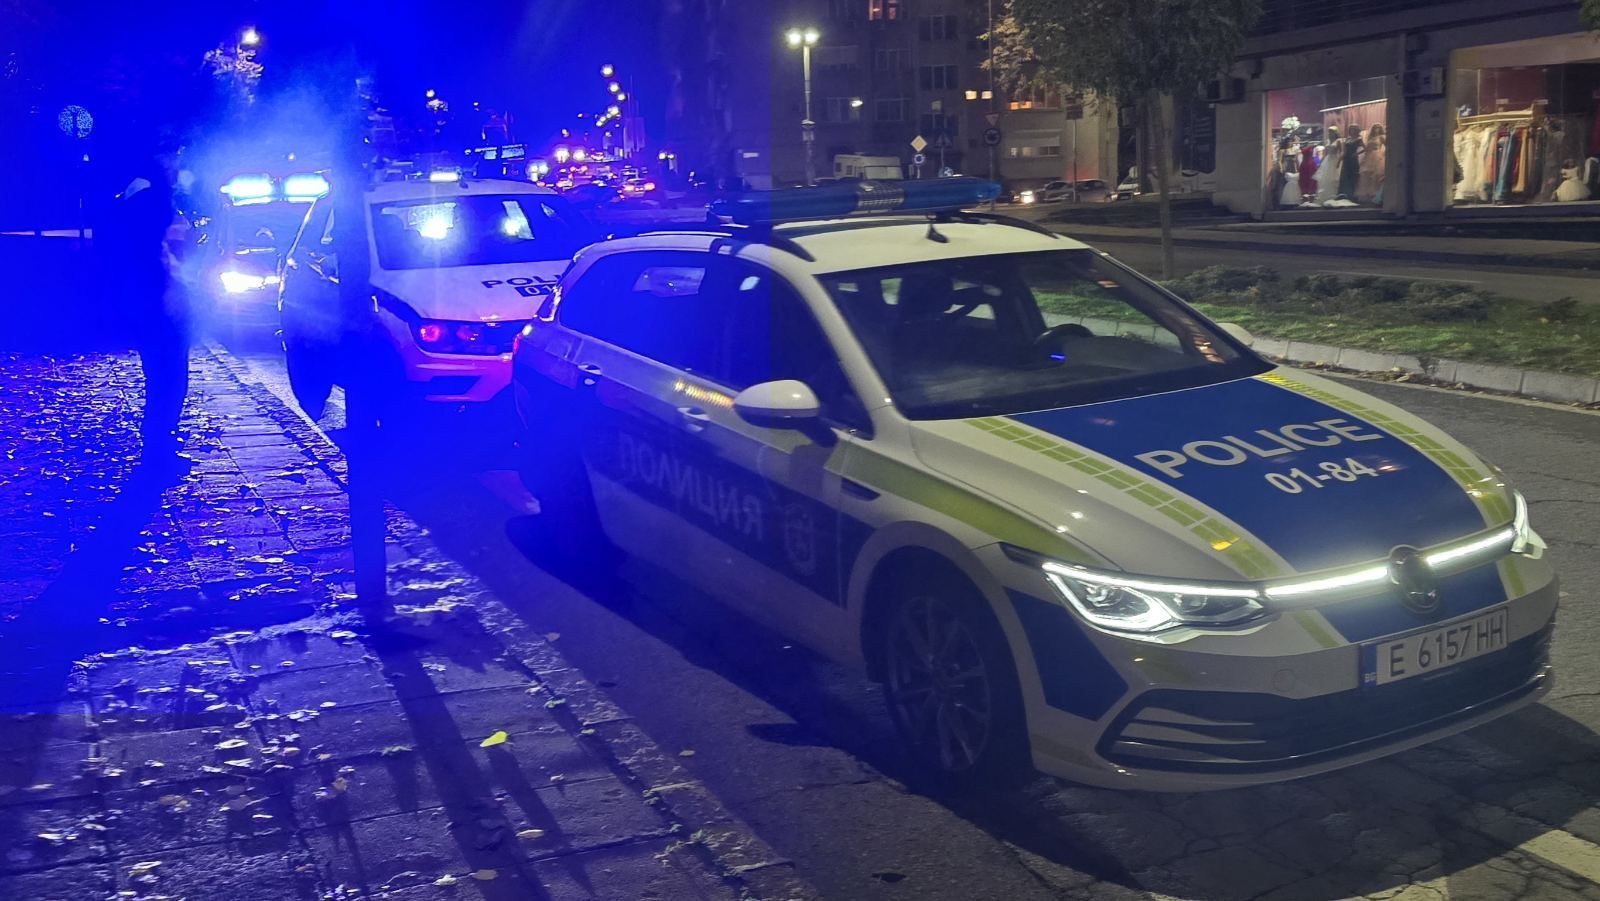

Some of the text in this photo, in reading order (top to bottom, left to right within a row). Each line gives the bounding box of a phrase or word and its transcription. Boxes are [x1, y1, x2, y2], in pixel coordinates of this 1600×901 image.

[1134, 418, 1384, 479] POLICE
[1264, 457, 1379, 494] 01-84
[619, 431, 763, 542] ПОЛИЦИЯ
[1390, 614, 1503, 677] E 6157 HH
